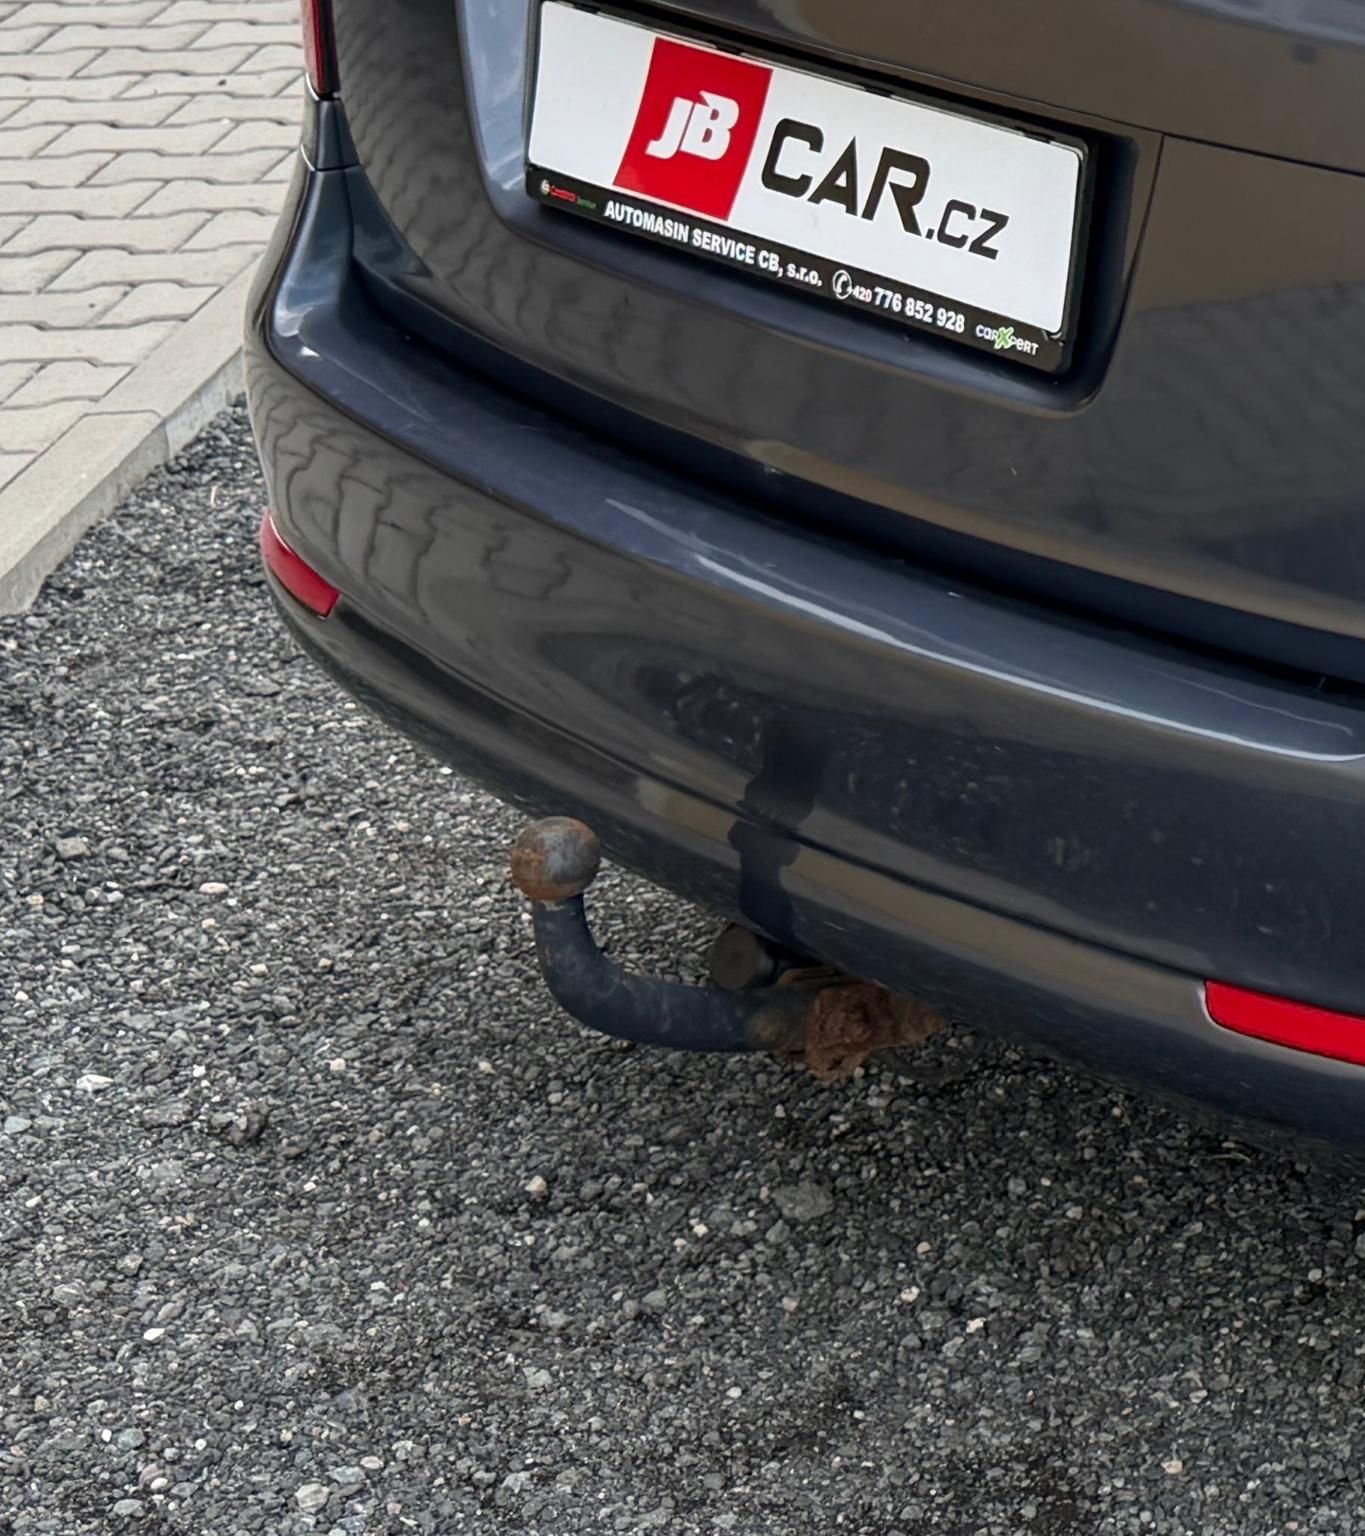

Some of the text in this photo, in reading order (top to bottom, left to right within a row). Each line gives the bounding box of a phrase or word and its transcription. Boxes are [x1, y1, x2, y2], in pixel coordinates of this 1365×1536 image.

[645, 90, 740, 161] JB
[604, 200, 689, 243] AUTOMASIN
[692, 228, 756, 265] SERVICE
[758, 250, 783, 278] CB,
[786, 264, 823, 287] s.r.o.
[874, 287, 902, 312] 776
[905, 298, 933, 324] 852
[936, 308, 966, 334] 928
